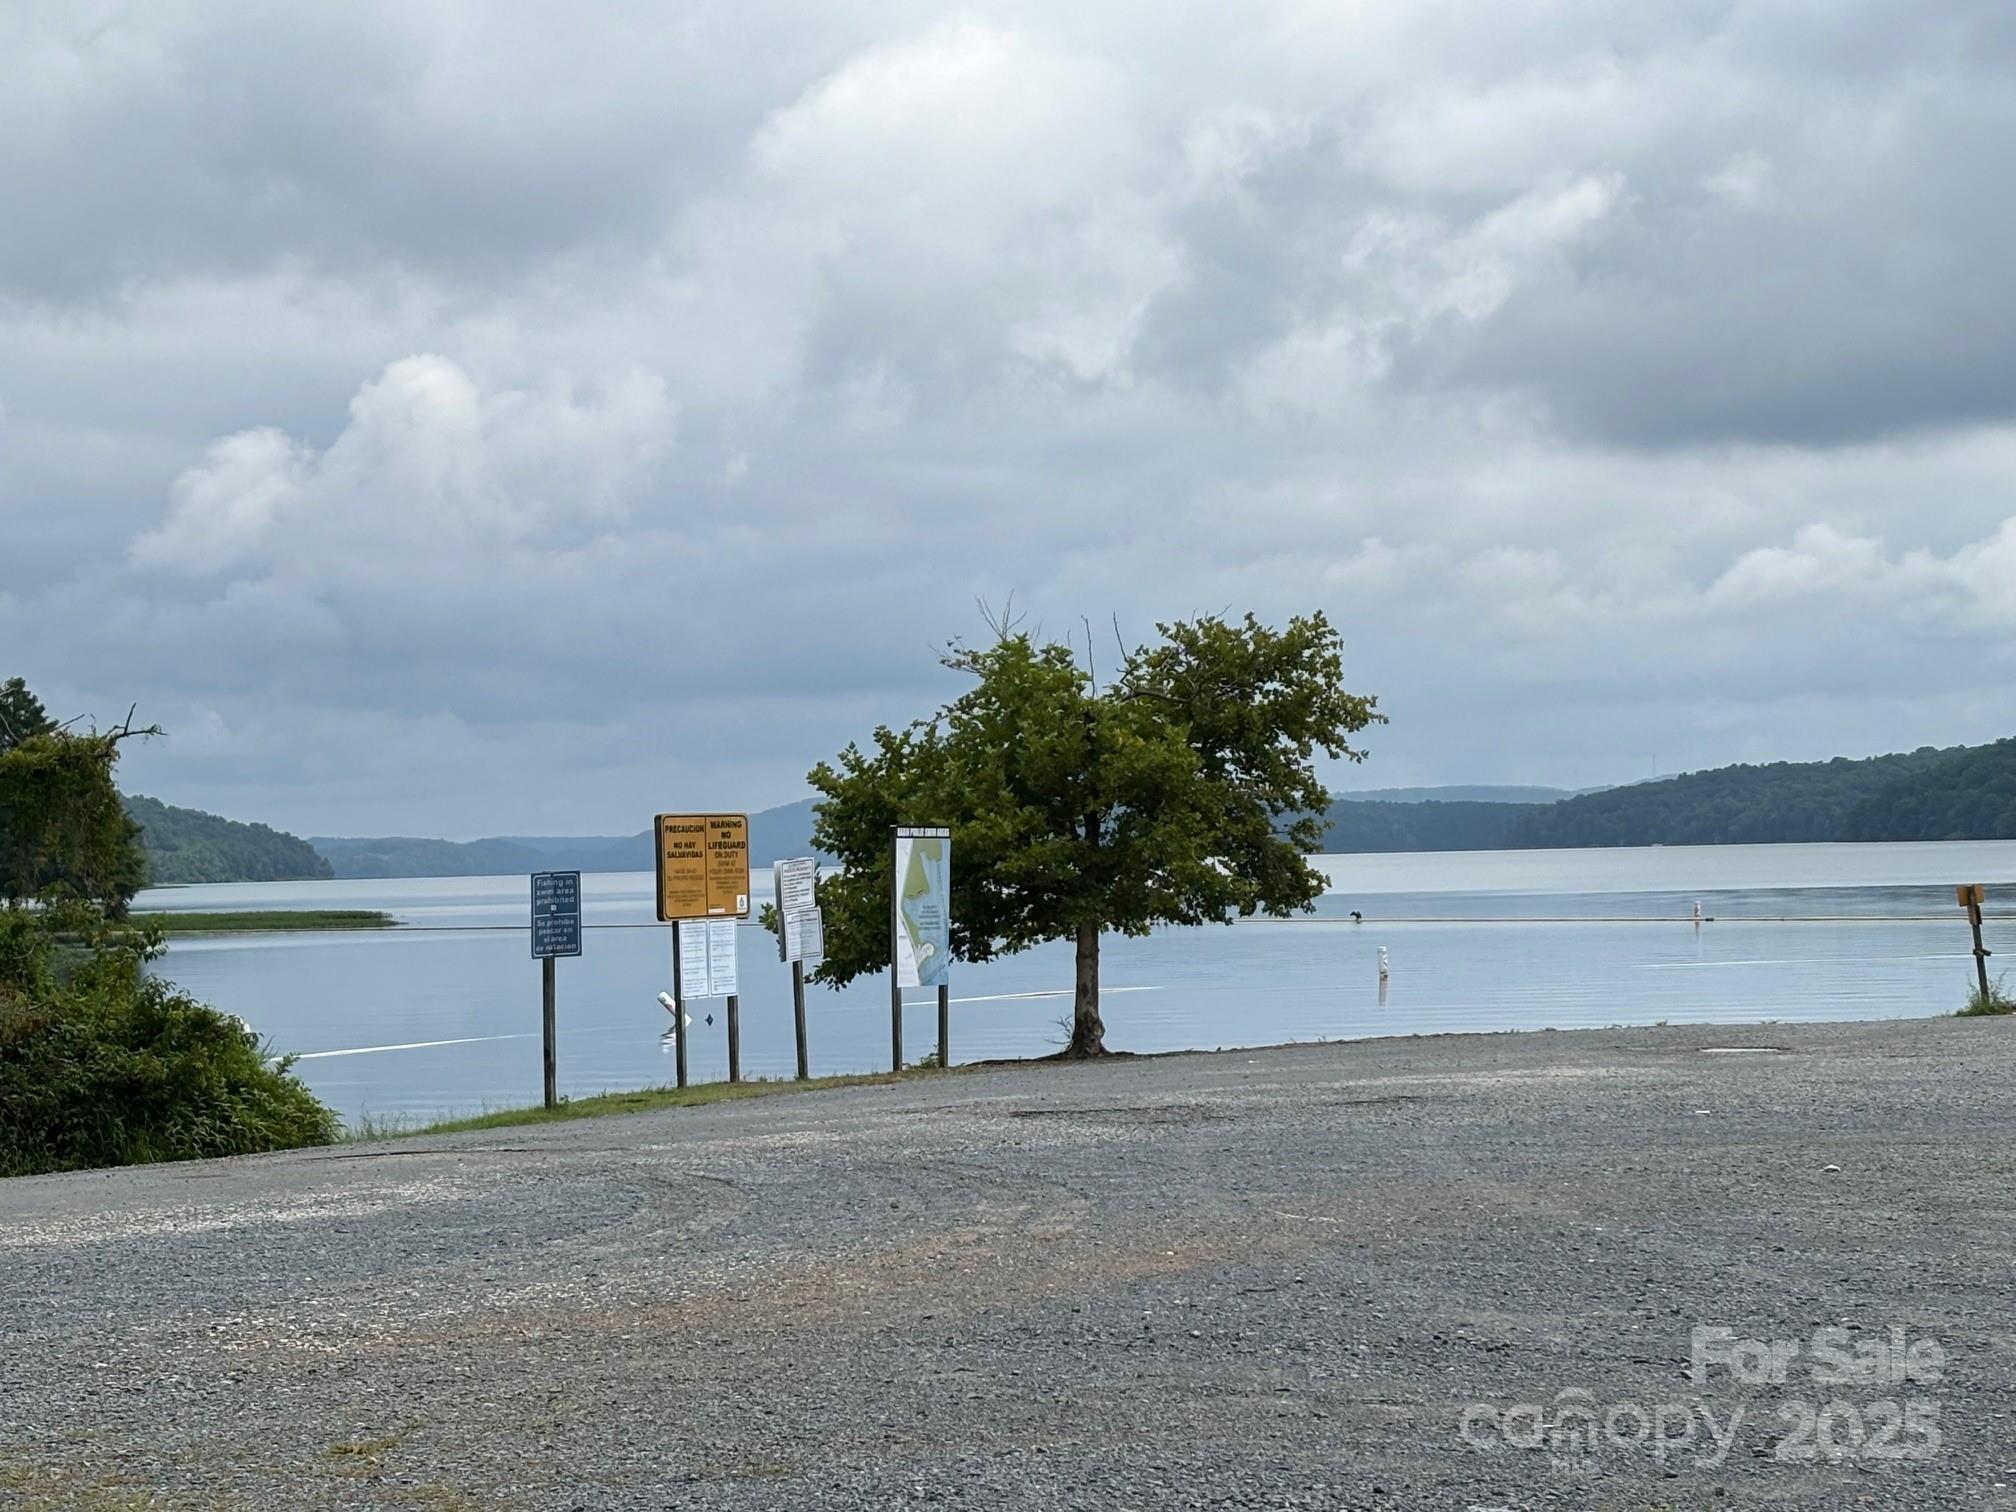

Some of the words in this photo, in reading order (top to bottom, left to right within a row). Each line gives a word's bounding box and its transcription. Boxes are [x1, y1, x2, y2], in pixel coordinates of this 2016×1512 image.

[710, 820, 742, 829] WARNING
[665, 825, 705, 833] PRECAUCION
[721, 831, 731, 839] NO
[673, 841, 682, 849] NO
[684, 841, 696, 849] HAY
[708, 841, 746, 850] LIFEGUARD
[667, 850, 703, 858] SALVAVIDAS
[536, 879, 564, 887] Fishing
[536, 896, 575, 906] prohibited
[547, 918, 574, 927] prohibe
[538, 928, 562, 936] pescar
